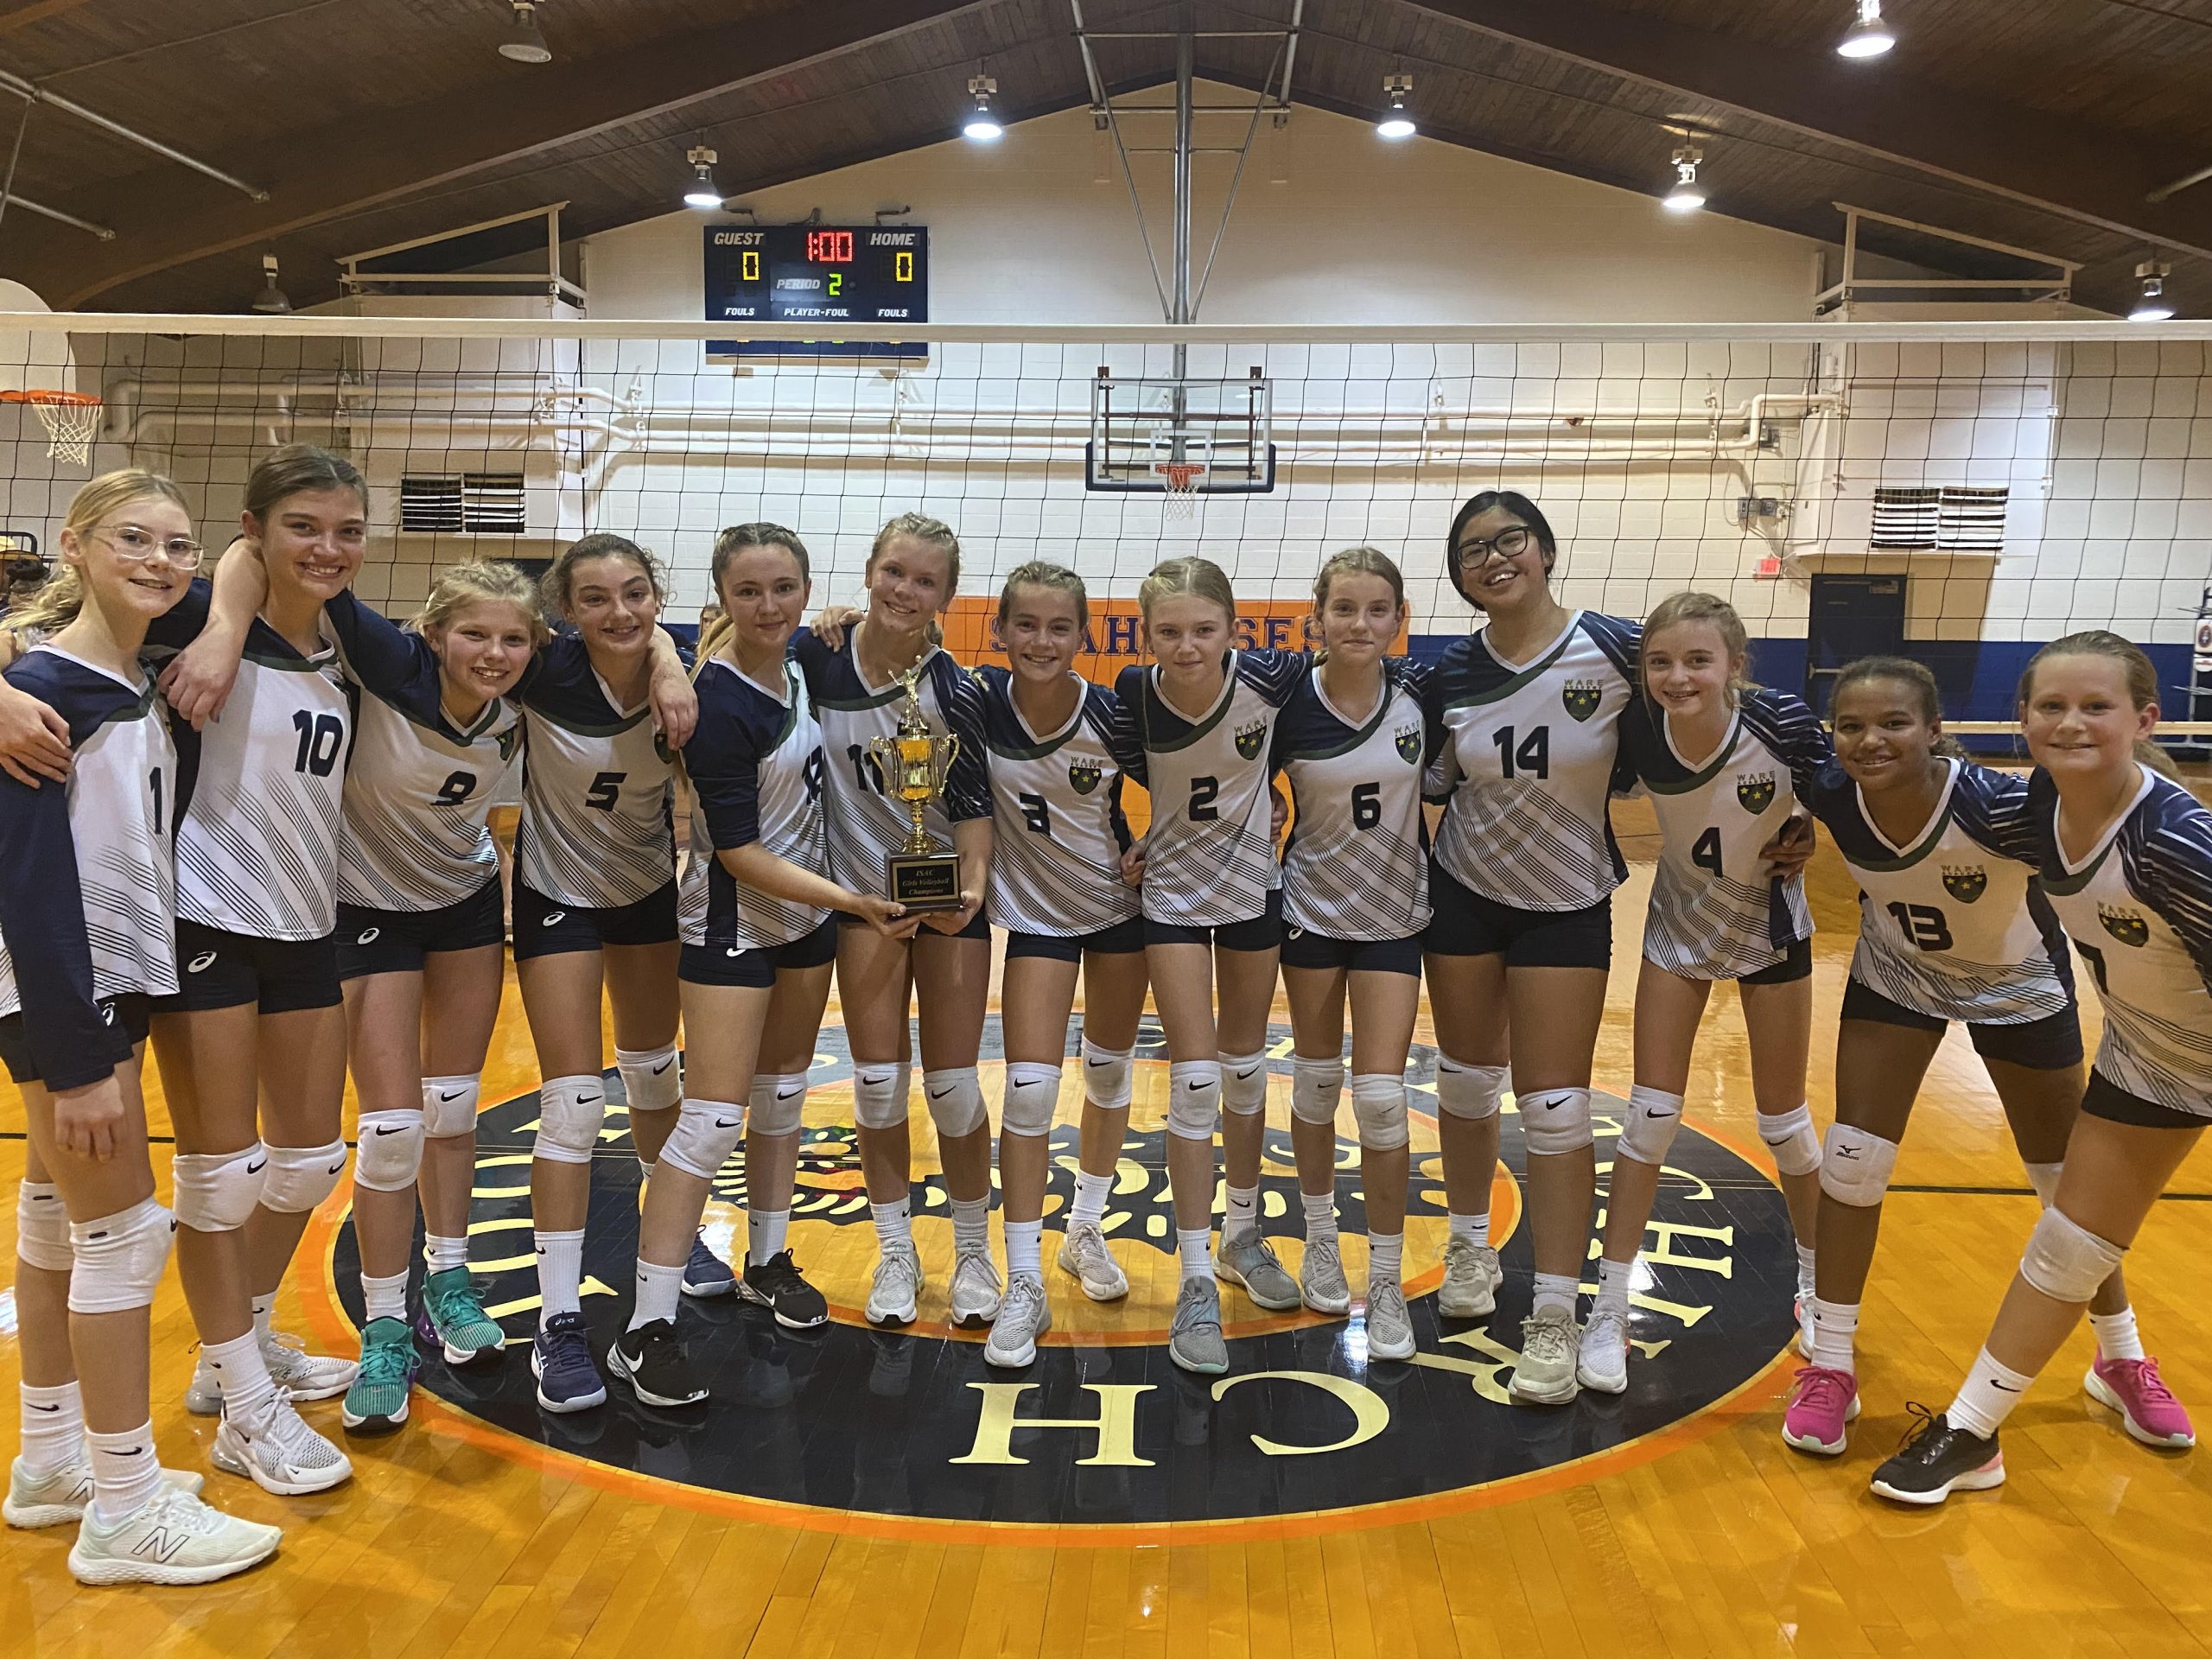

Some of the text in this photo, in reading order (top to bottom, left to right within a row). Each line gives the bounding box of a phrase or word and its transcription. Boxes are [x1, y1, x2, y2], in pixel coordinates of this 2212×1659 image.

[714, 232, 764, 245] GUEST
[806, 232, 853, 262] 1:00
[870, 232, 916, 246] HOME
[742, 251, 760, 281] 0
[896, 252, 912, 282] 0
[776, 278, 821, 290] PERIOD
[829, 273, 843, 296] 2
[725, 308, 755, 317] FOULS
[784, 308, 849, 318] PLAYER-FOUL
[878, 308, 908, 318] FOULS
[292, 709, 344, 777] 10
[1492, 725, 1549, 779] 14
[847, 743, 884, 796] 11
[1737, 770, 1776, 781] WARE
[149, 766, 162, 836] 1
[585, 772, 628, 812] 5
[1189, 775, 1219, 821] 2
[1351, 781, 1382, 831] 6
[1019, 791, 1052, 837] 3
[1691, 827, 1724, 879] 4
[1886, 901, 1954, 951] 13
